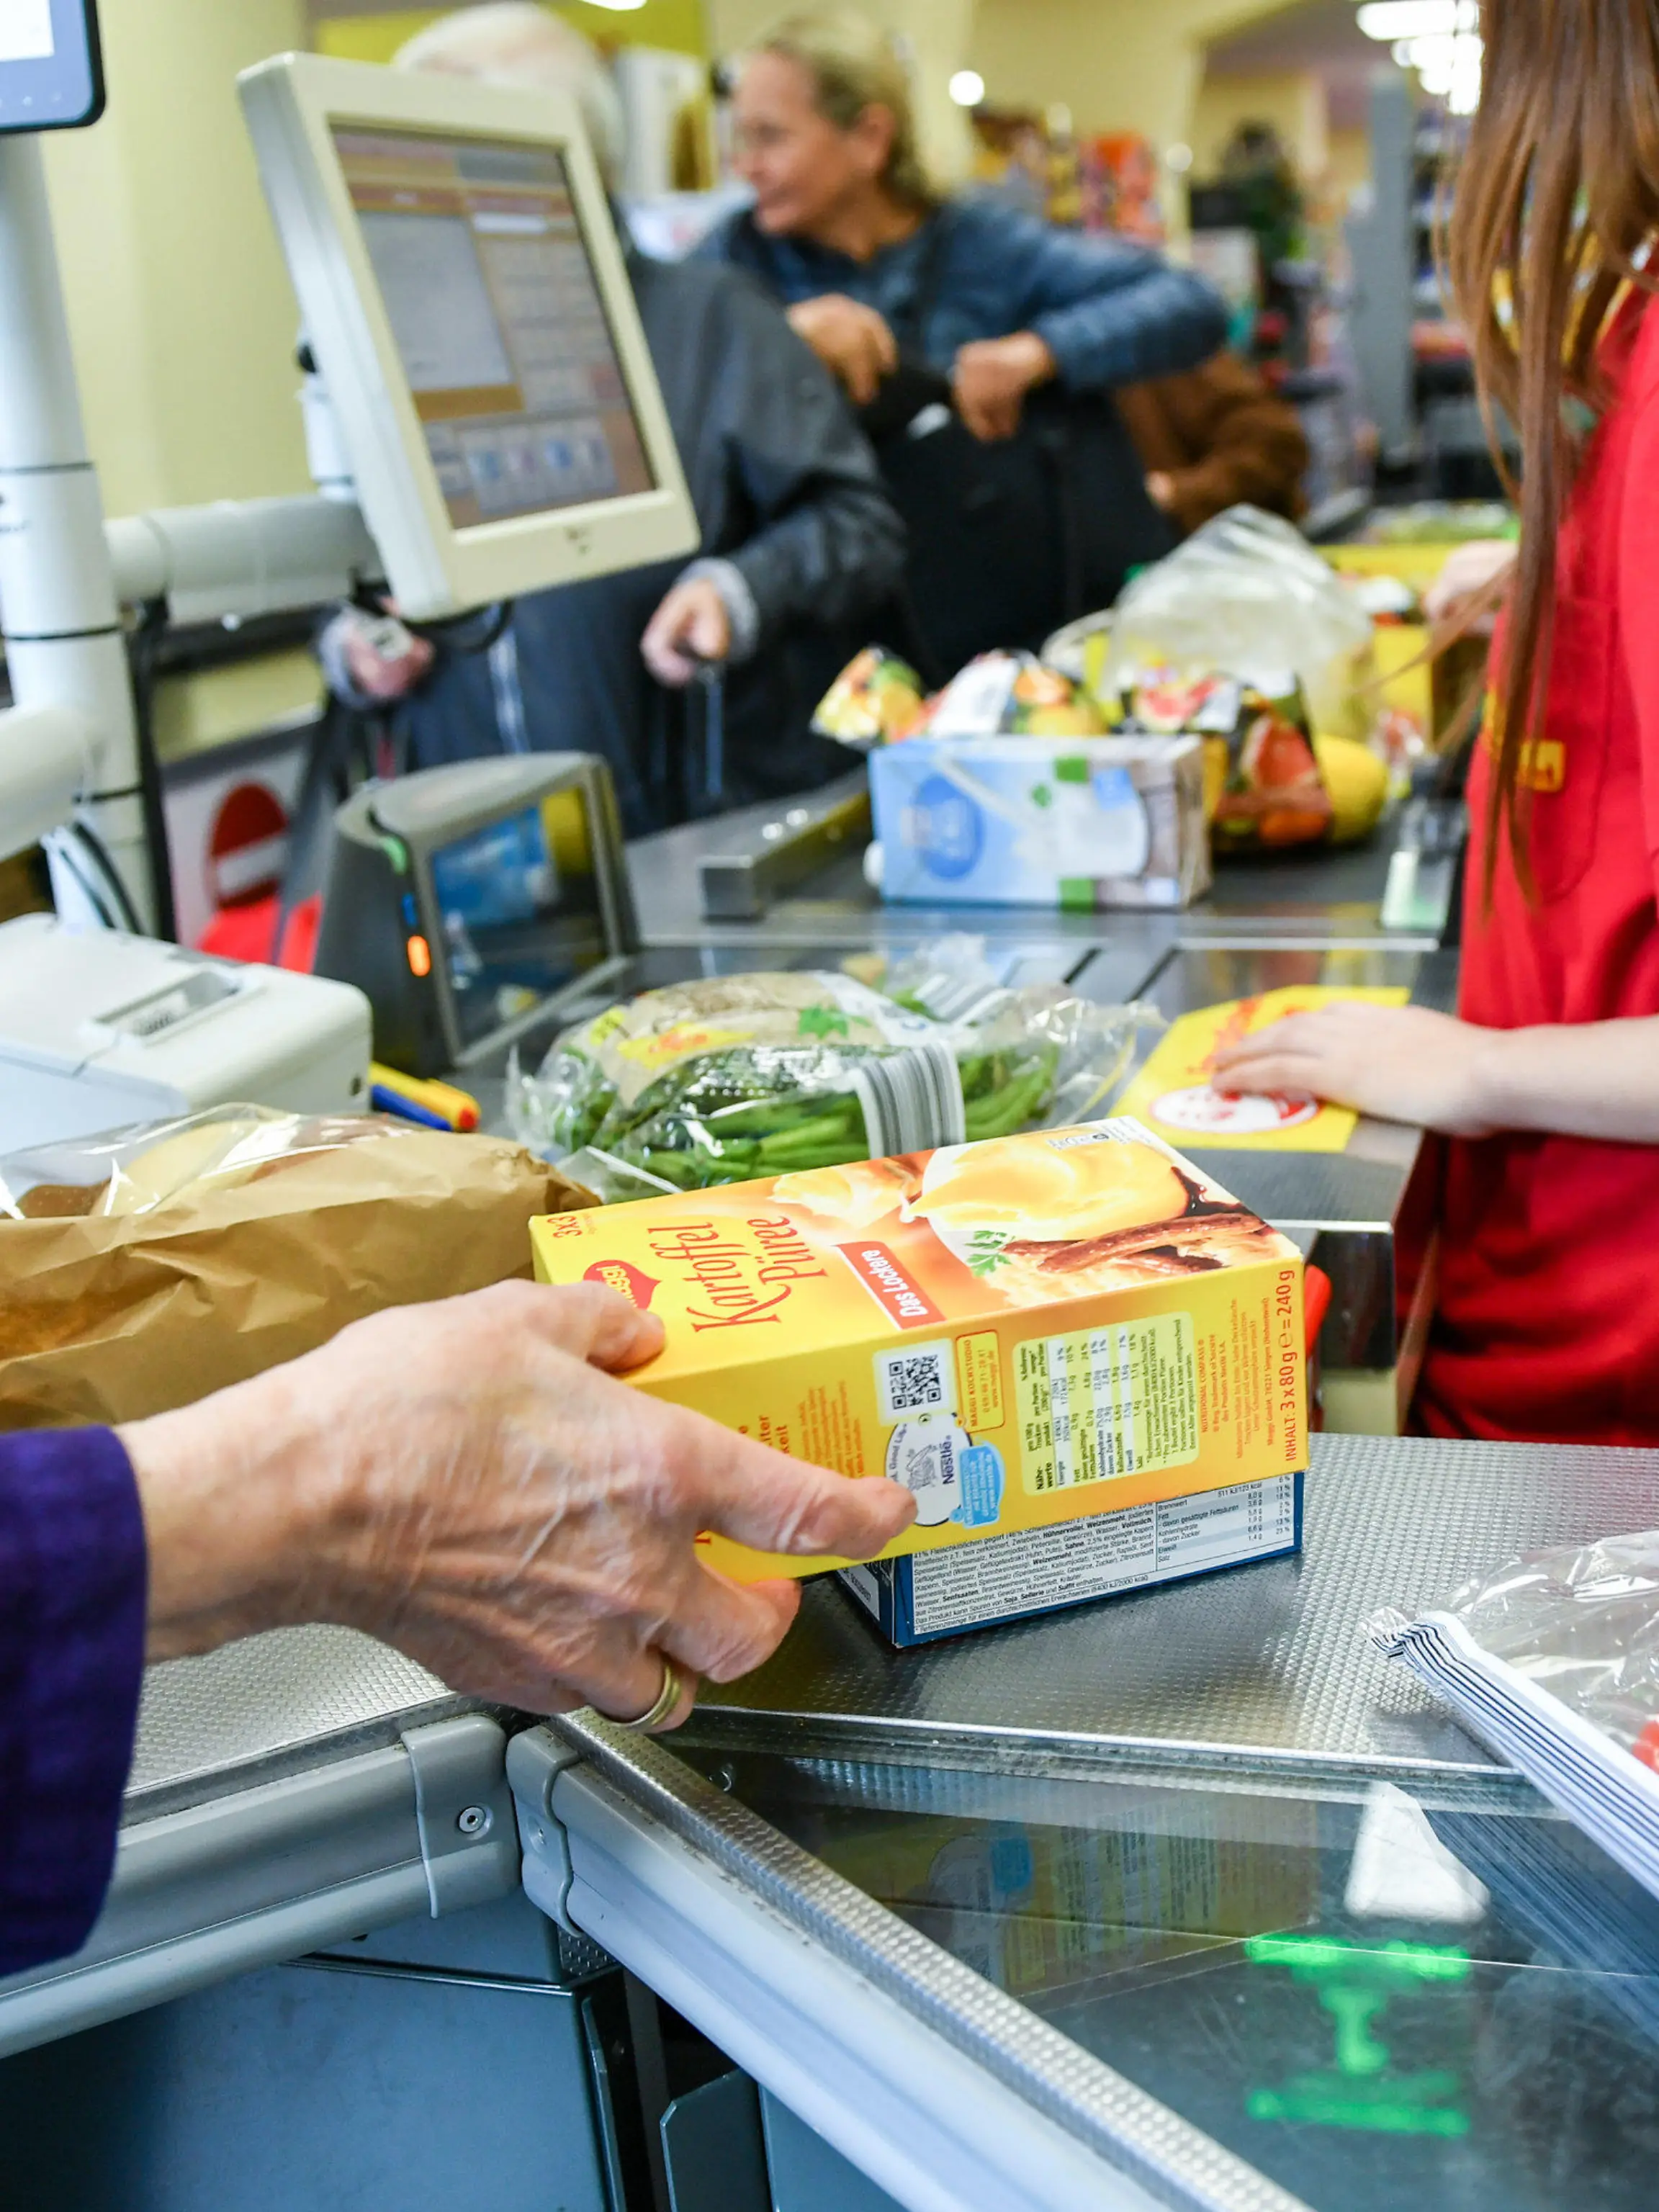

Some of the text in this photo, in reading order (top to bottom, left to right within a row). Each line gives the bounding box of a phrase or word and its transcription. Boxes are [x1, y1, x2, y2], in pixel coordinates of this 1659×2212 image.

[547, 1215, 583, 1238] 3x3
[747, 1216, 828, 1285] Püree
[648, 1222, 791, 1333] Kartoffel
[861, 1249, 927, 1317] Das Lockere
[1279, 1268, 1294, 1280] g
[1276, 1283, 1291, 1316] 240
[1282, 1351, 1297, 1362] g
[963, 1339, 977, 1426] MAGGI KOCHSTUDIO
[1279, 1364, 1293, 1386] 80
[1284, 1388, 1294, 1398] x
[1280, 1400, 1294, 1411] 3
[1284, 1412, 1296, 1461] INHALT:
[938, 1440, 954, 1484] Nestlé
[1035, 1465, 1043, 1489] Nähr-
[1158, 1499, 1187, 1511] Brennwert
[1158, 1511, 1169, 1520] Fett
[1162, 1528, 1200, 1544] davon Zucker
[1158, 1554, 1170, 1563] Salz
[927, 1611, 953, 1622] Produkt
[953, 1607, 968, 1616] kann
[968, 1601, 991, 1612] Spuren
[1021, 1589, 1044, 1600] Sellerie
